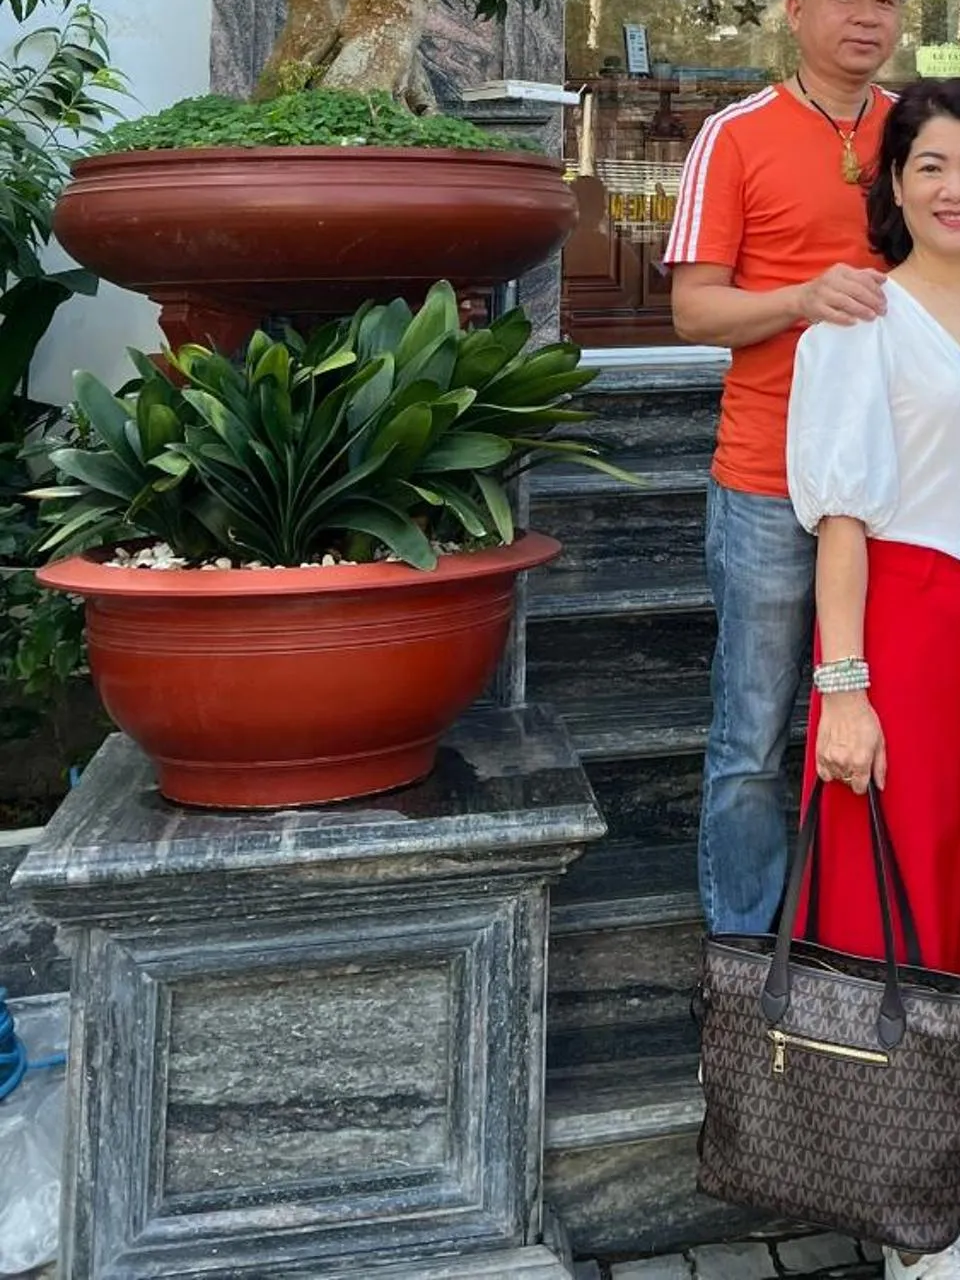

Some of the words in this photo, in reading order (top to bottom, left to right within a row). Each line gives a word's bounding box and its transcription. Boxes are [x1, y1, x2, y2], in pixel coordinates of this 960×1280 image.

[748, 1078, 776, 1096] MK
[827, 1099, 855, 1117] MK
[856, 1104, 884, 1122] MK
[817, 1077, 845, 1095] MK
[738, 1116, 766, 1134] MK
[766, 1122, 794, 1140] MK
[757, 1100, 785, 1118] MK
[837, 1121, 865, 1139] MK
[758, 1159, 786, 1177] MK
[785, 1167, 813, 1185] MK
[812, 1174, 840, 1192] MK
[767, 1181, 795, 1199] MK
[795, 1189, 823, 1207] MK
[823, 1196, 851, 1214] MK
